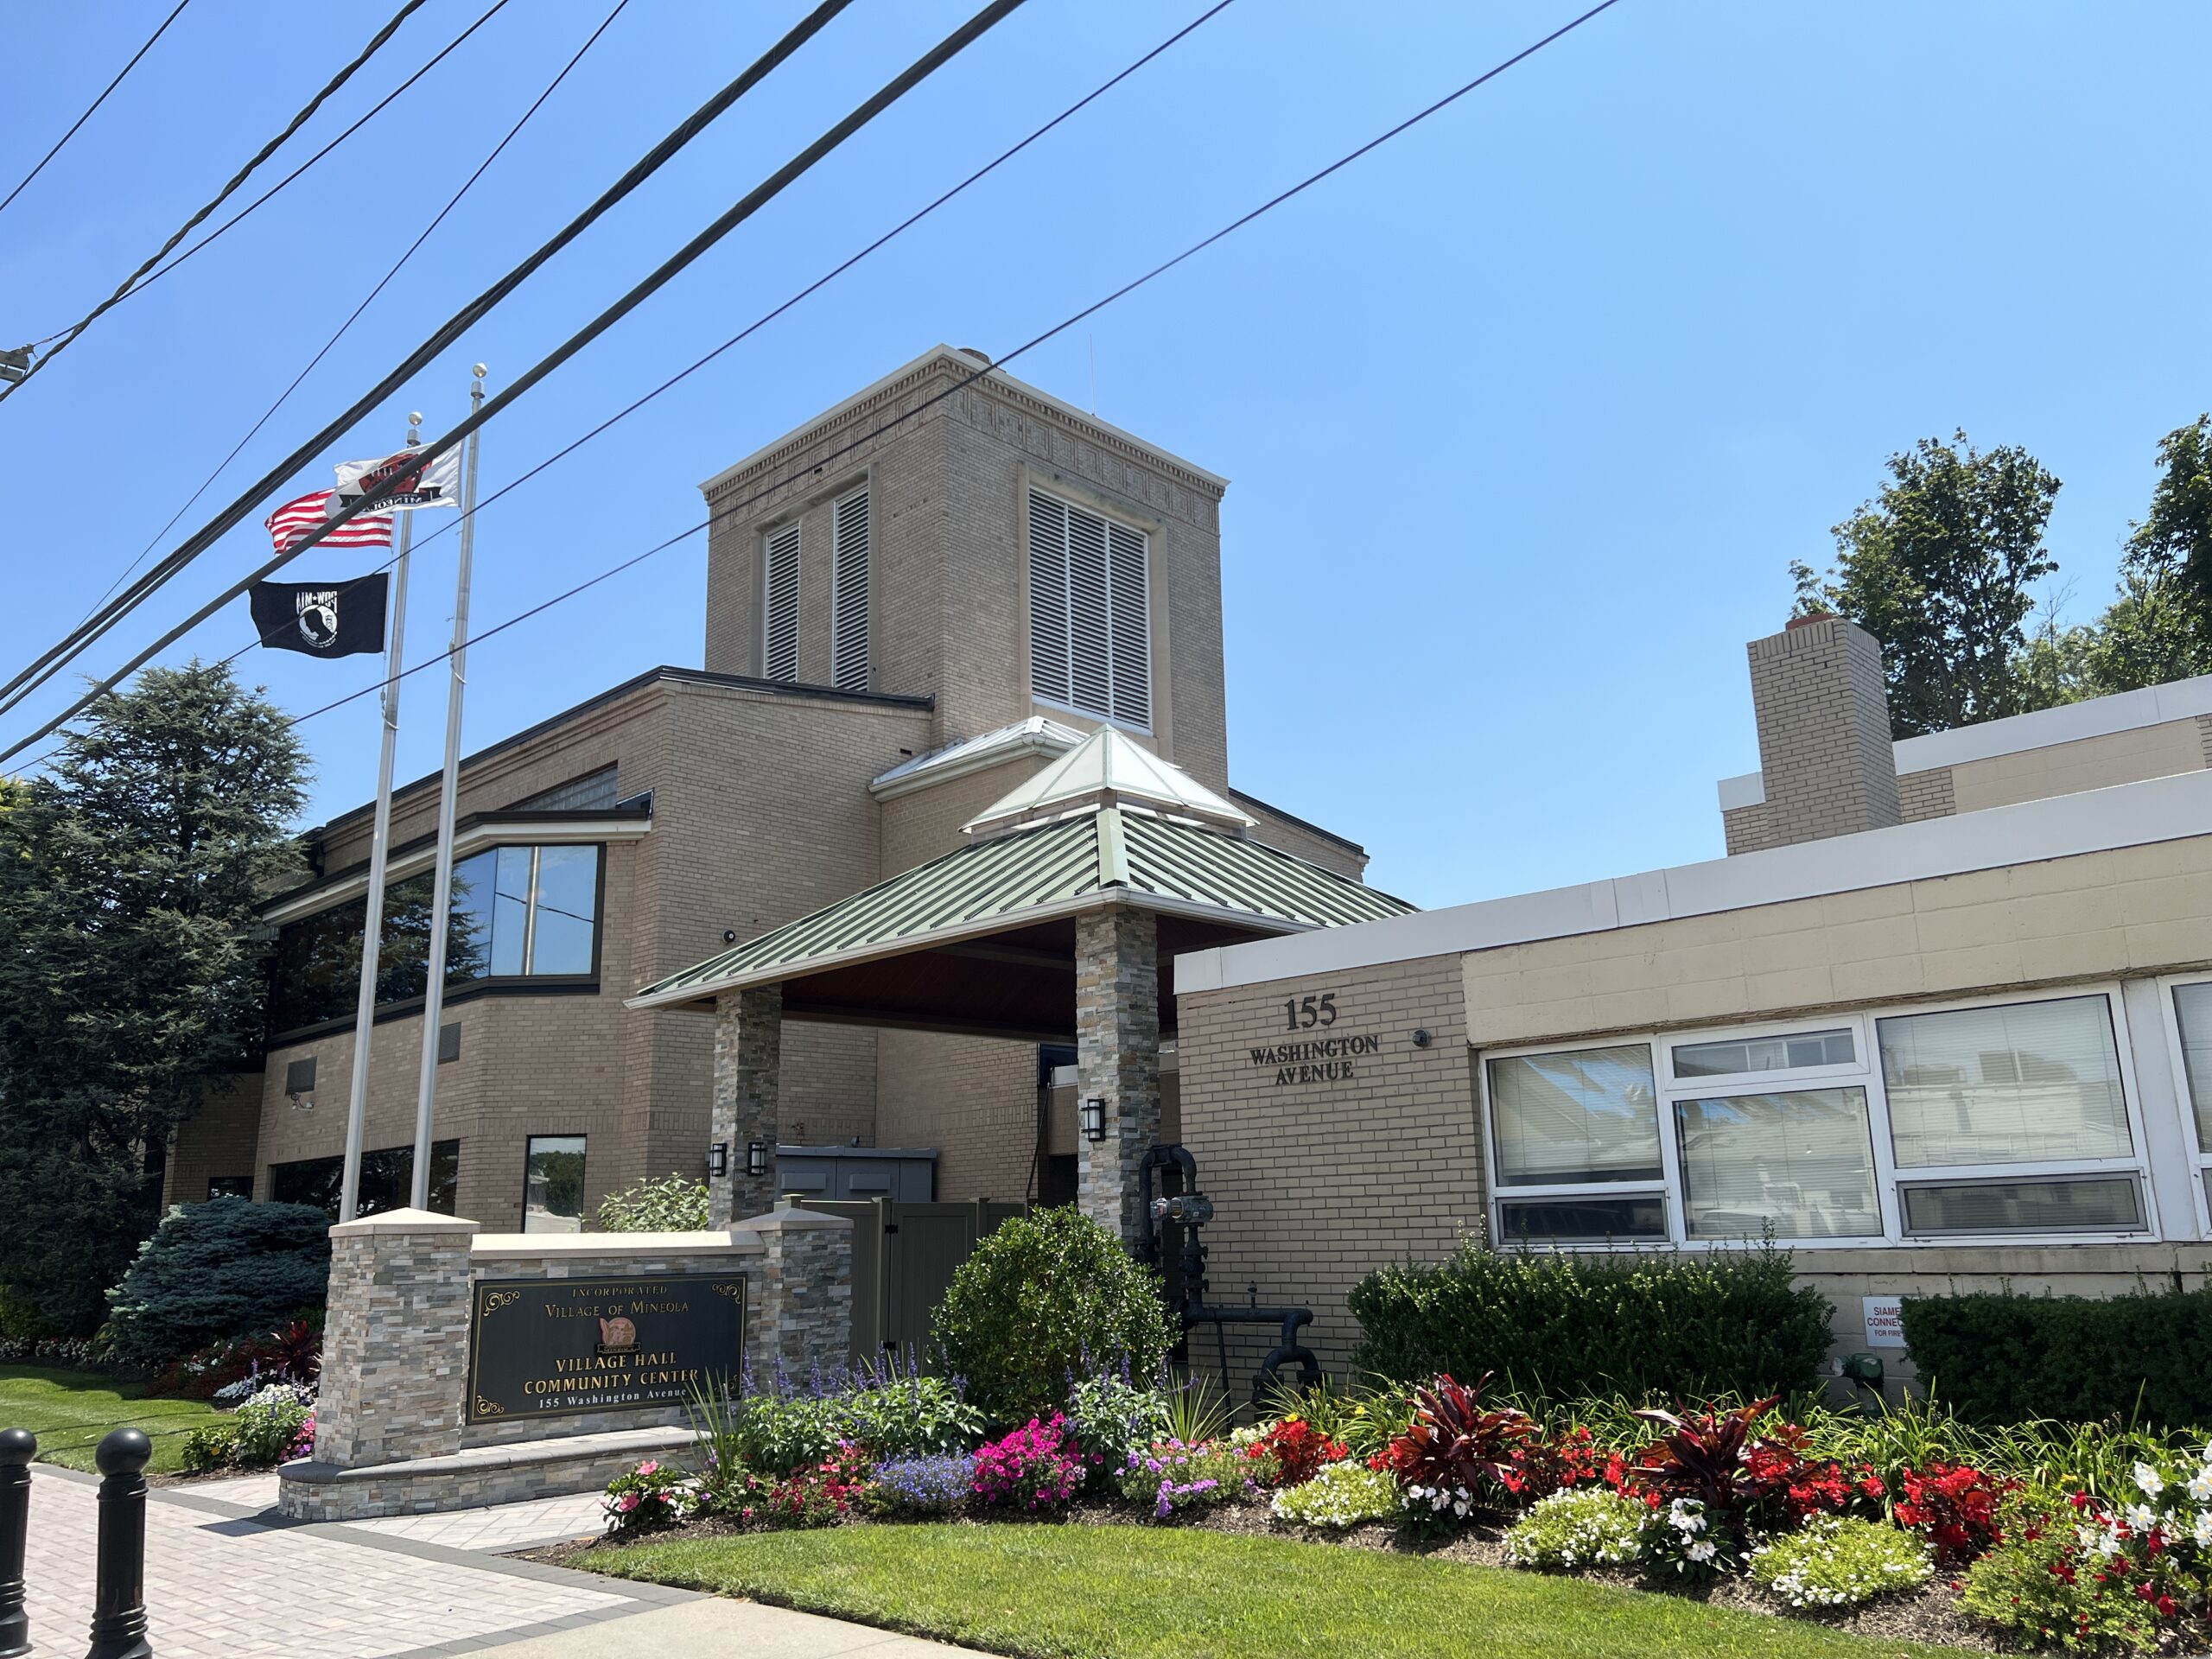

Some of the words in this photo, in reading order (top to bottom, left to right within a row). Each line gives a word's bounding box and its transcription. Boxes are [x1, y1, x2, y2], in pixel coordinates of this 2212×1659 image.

[1284, 993, 1337, 1031] 155
[1249, 1035, 1379, 1065] WASHINGTON
[1275, 1061, 1354, 1086] AVENUE
[573, 1285, 668, 1298] INCORPORATED
[545, 1304, 600, 1318] VILLAGE
[608, 1305, 624, 1315] OF
[631, 1300, 690, 1314] MINEOLA
[1873, 1306, 1902, 1316] SIAME
[1867, 1317, 1904, 1327] CONNEC
[556, 1355, 627, 1373] VILLAGE
[634, 1351, 677, 1367] HALL
[524, 1373, 632, 1395] COMMUNITY
[639, 1369, 699, 1385] CENTER
[539, 1397, 560, 1409] 155
[567, 1392, 640, 1405] Washington
[647, 1388, 687, 1399] Avenue
